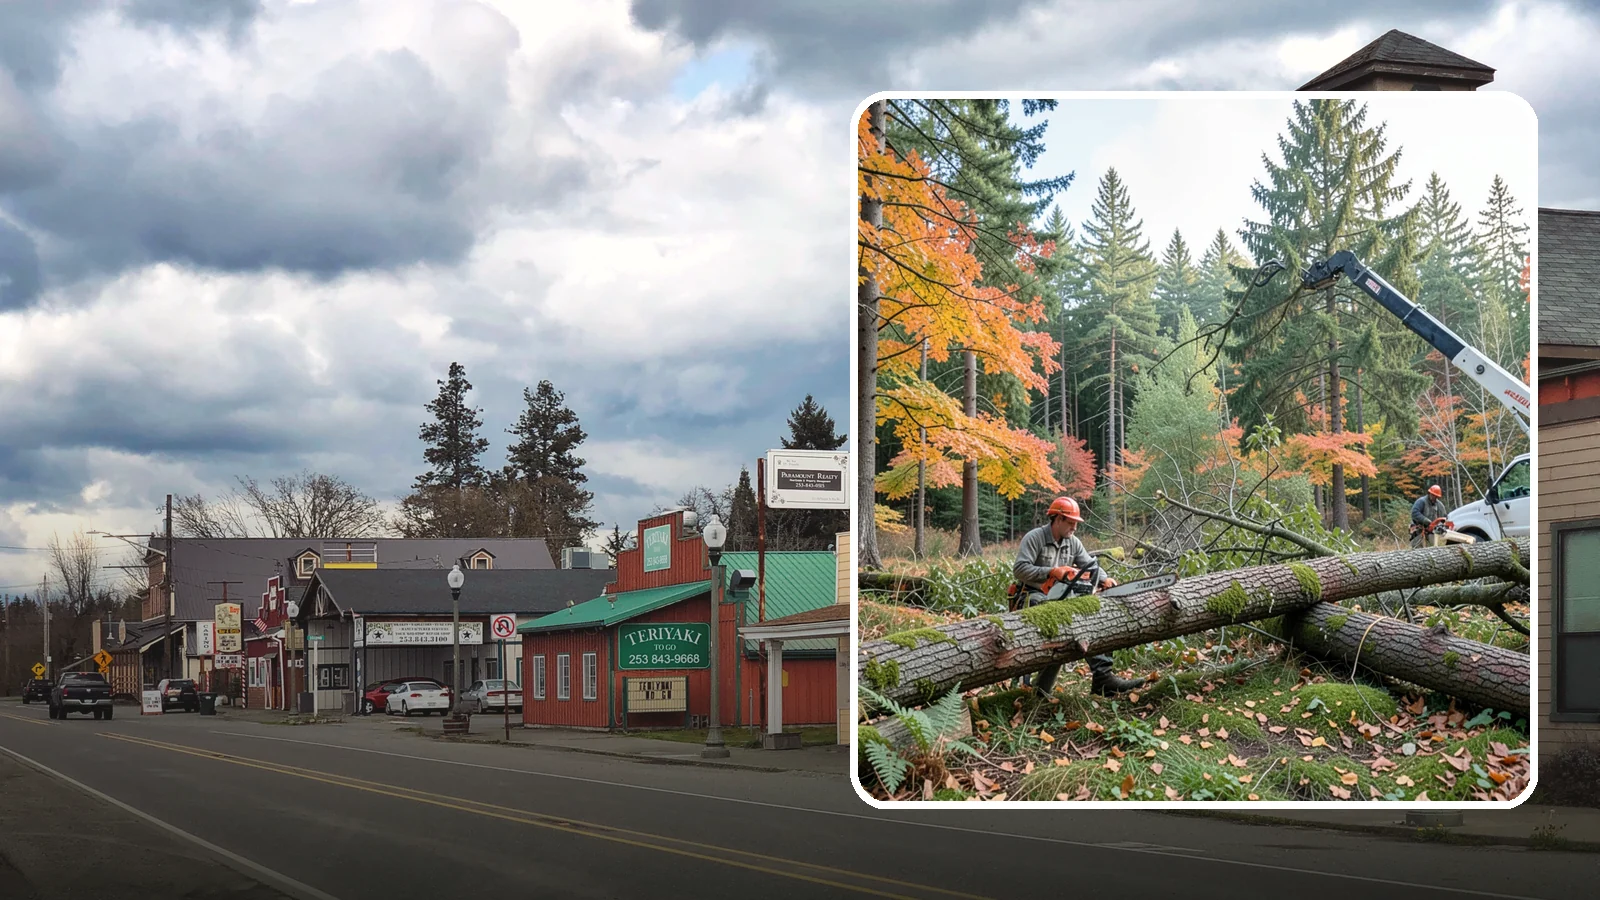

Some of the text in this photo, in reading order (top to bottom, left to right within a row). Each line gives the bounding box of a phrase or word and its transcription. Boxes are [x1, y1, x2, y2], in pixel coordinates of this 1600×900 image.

[781, 471, 838, 480] PARAMOUNT REALTY
[625, 627, 702, 646] TERIYAKI
[628, 653, 700, 665] 253 843-9668
[639, 681, 672, 691] TERIYAKI
